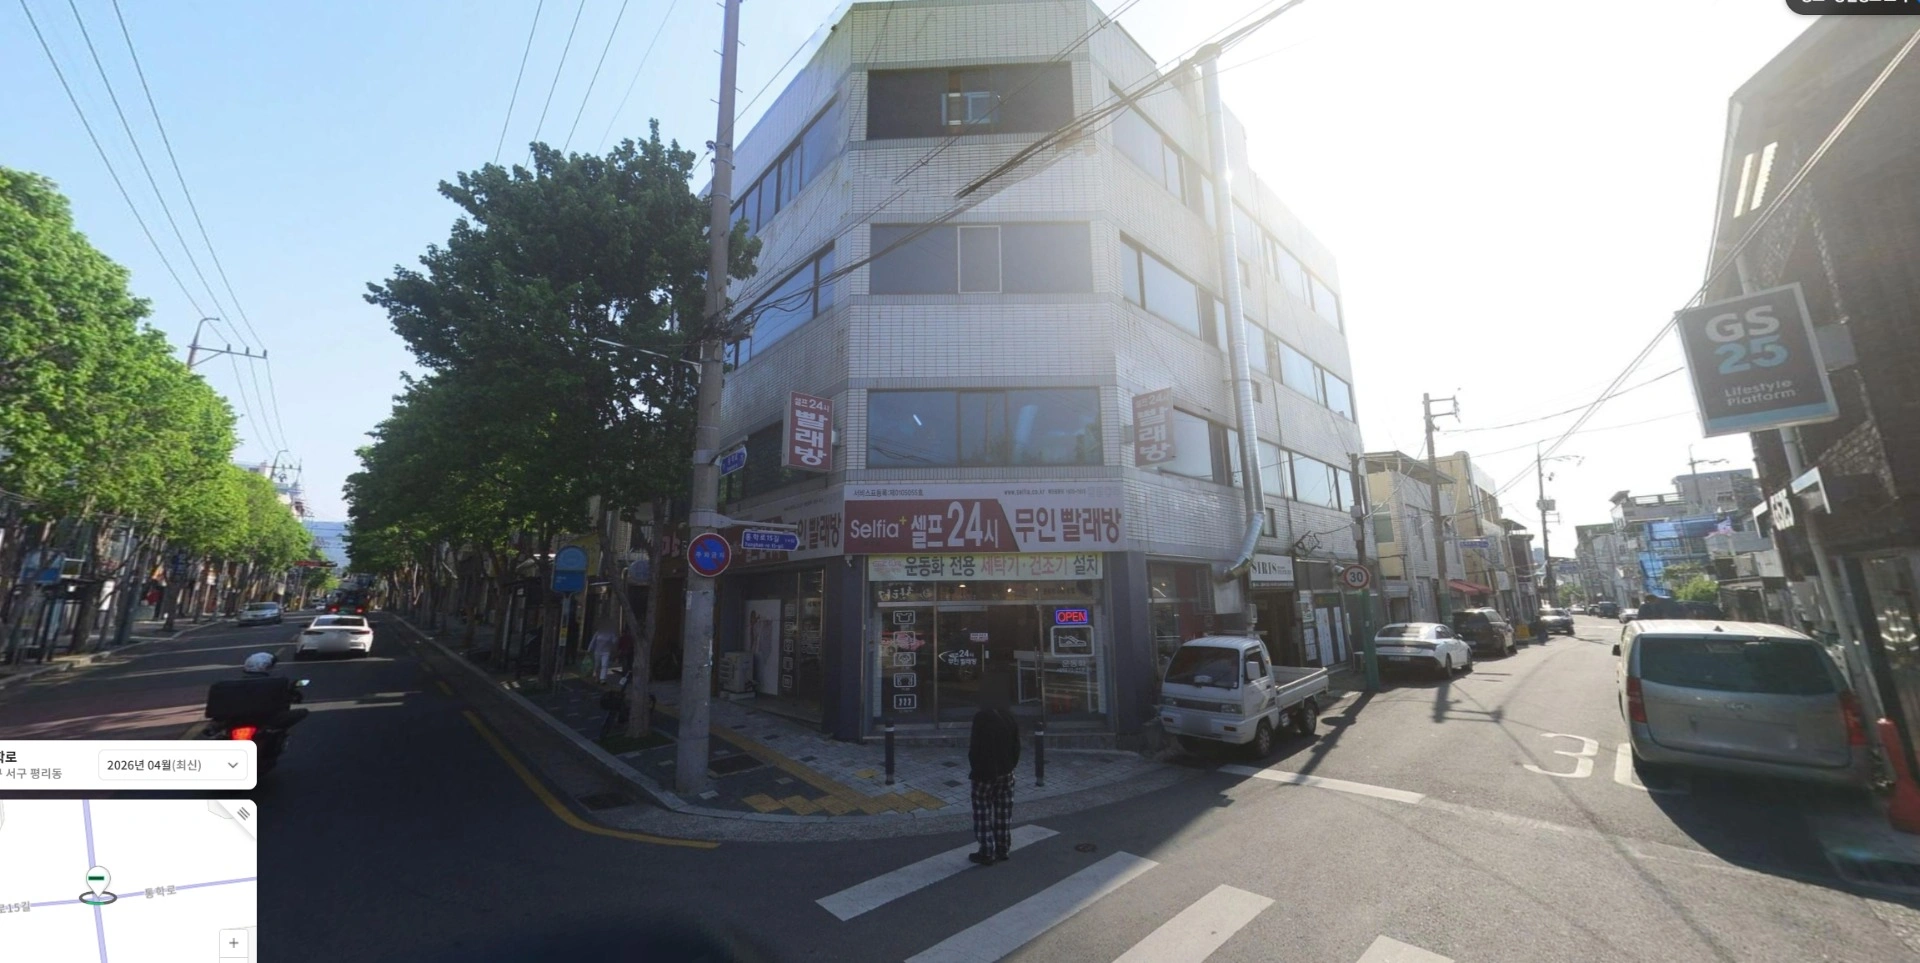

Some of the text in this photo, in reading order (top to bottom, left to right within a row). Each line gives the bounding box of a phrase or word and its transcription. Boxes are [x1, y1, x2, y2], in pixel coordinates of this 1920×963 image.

[1704, 305, 1780, 343] GS
[1714, 334, 1788, 374] 25
[1724, 380, 1792, 398] Lifestyle
[1727, 389, 1796, 406] Platform
[794, 409, 828, 466] 빨래방
[1137, 406, 1171, 461] 빨래방
[809, 512, 842, 550] 빨래방
[1015, 507, 1055, 543] 무인
[1061, 507, 1122, 543] 빨래방
[905, 555, 945, 577] 운동화
[950, 555, 976, 577] 전용
[1073, 555, 1098, 576] 설치
[1251, 561, 1277, 575] SIRIS
[1349, 571, 1364, 583] 30
[1058, 611, 1087, 623] OPEN
